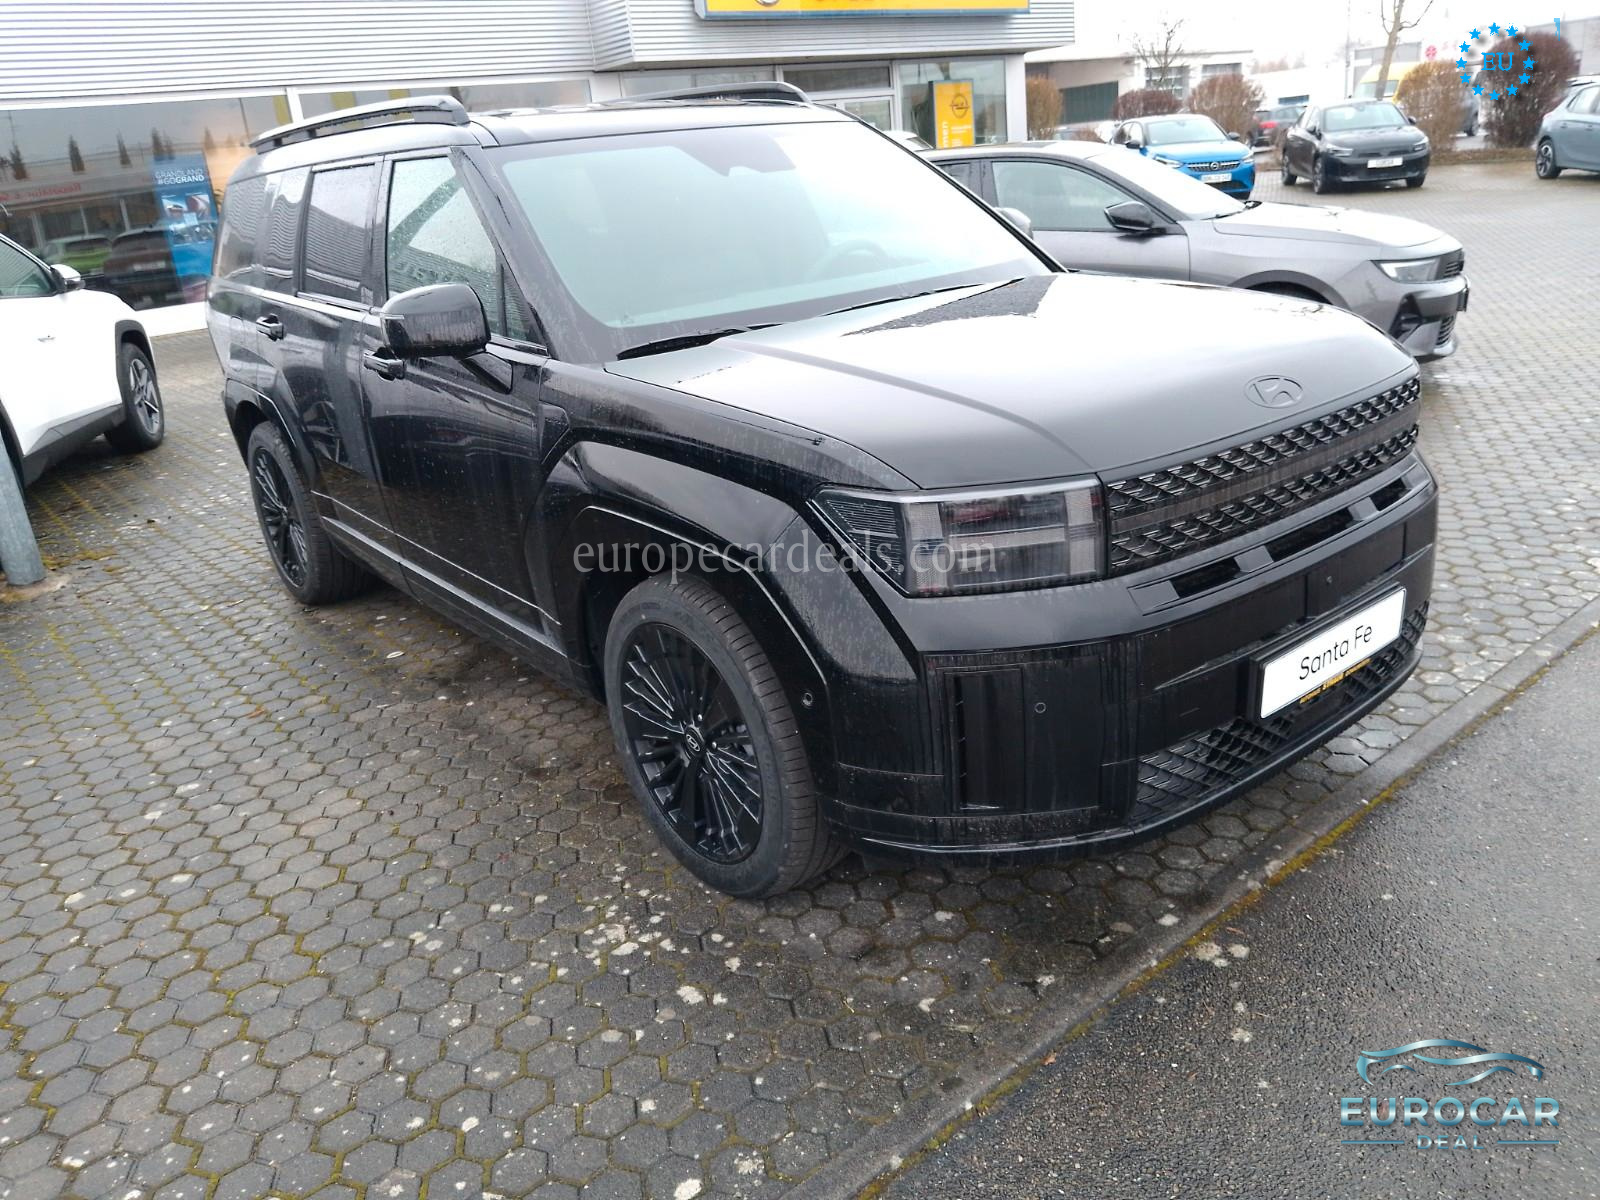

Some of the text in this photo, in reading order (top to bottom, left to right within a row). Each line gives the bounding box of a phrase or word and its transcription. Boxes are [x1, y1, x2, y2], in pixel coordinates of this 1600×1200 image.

[157, 174, 205, 185] #GOGRAND
[1298, 624, 1373, 680] Santa Fe
